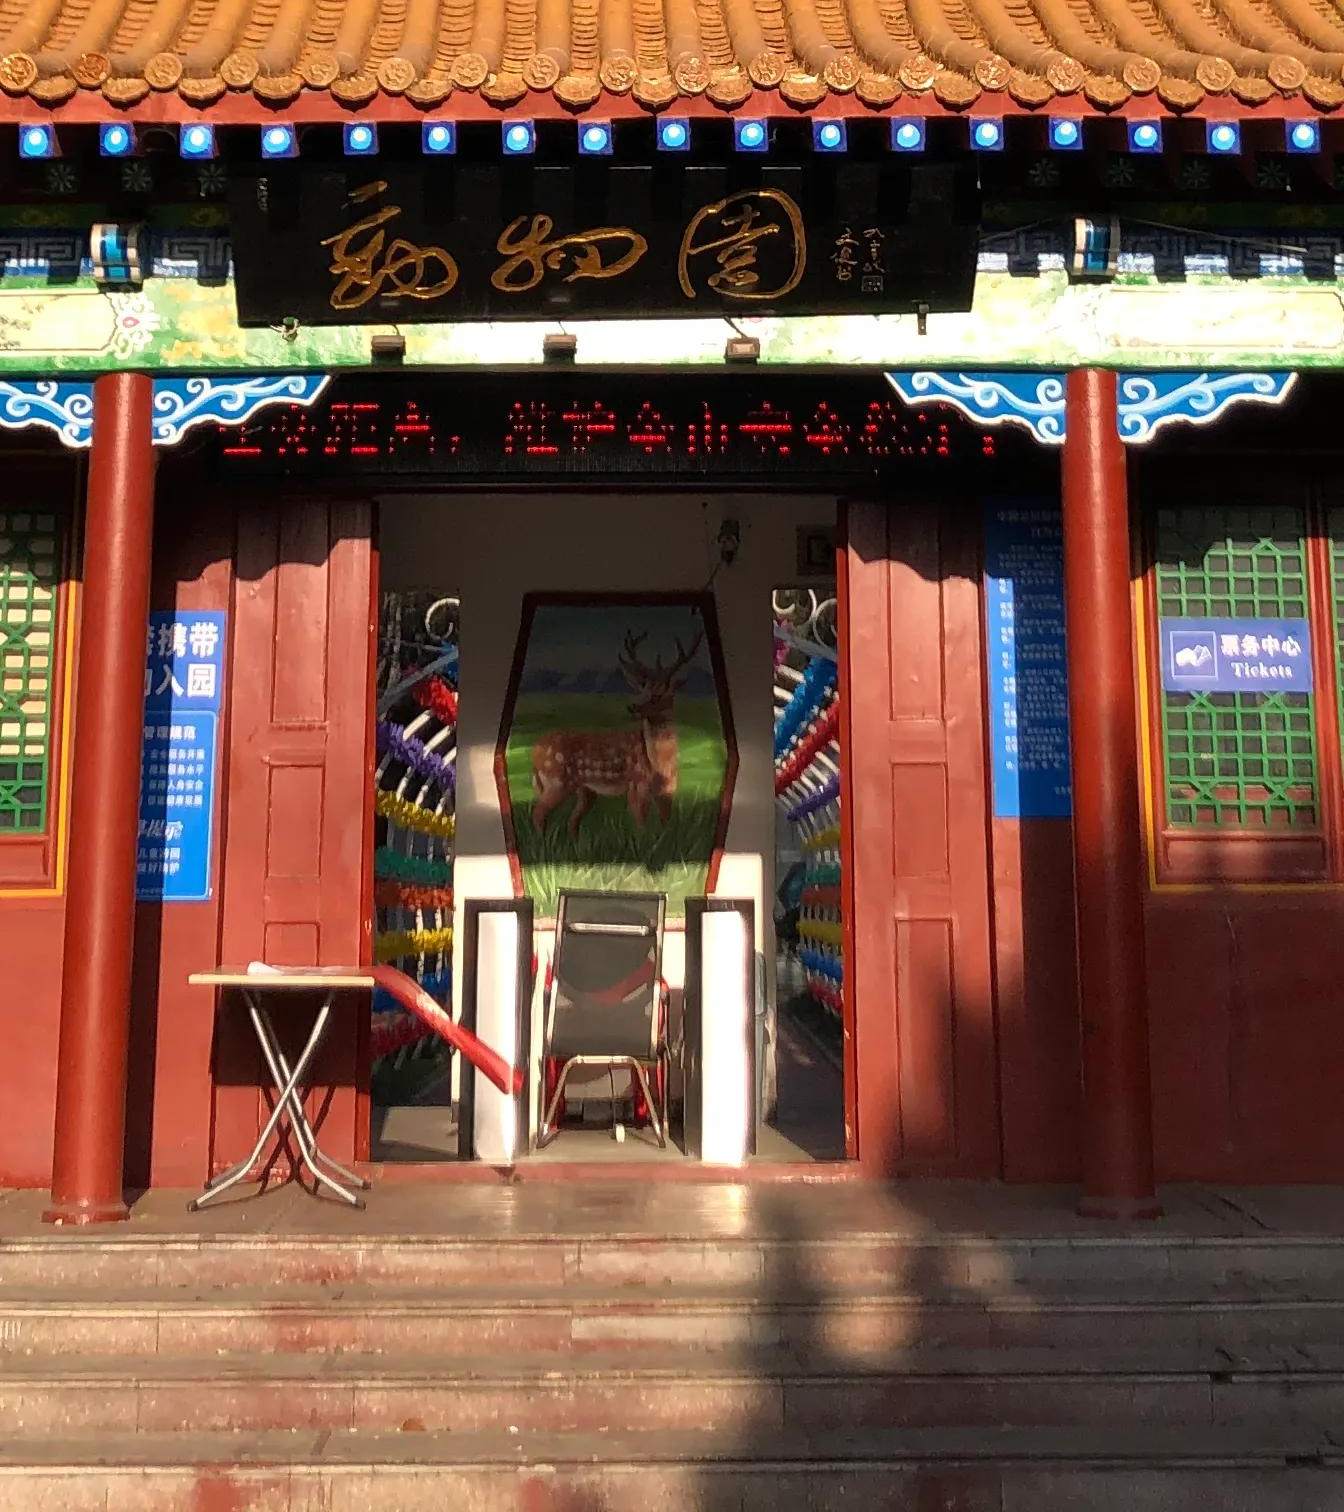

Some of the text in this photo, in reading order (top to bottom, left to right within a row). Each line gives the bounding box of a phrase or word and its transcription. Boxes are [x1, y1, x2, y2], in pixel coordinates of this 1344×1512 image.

[1220, 634, 1301, 658] 票务中心
[1231, 662, 1293, 679] Tickets
